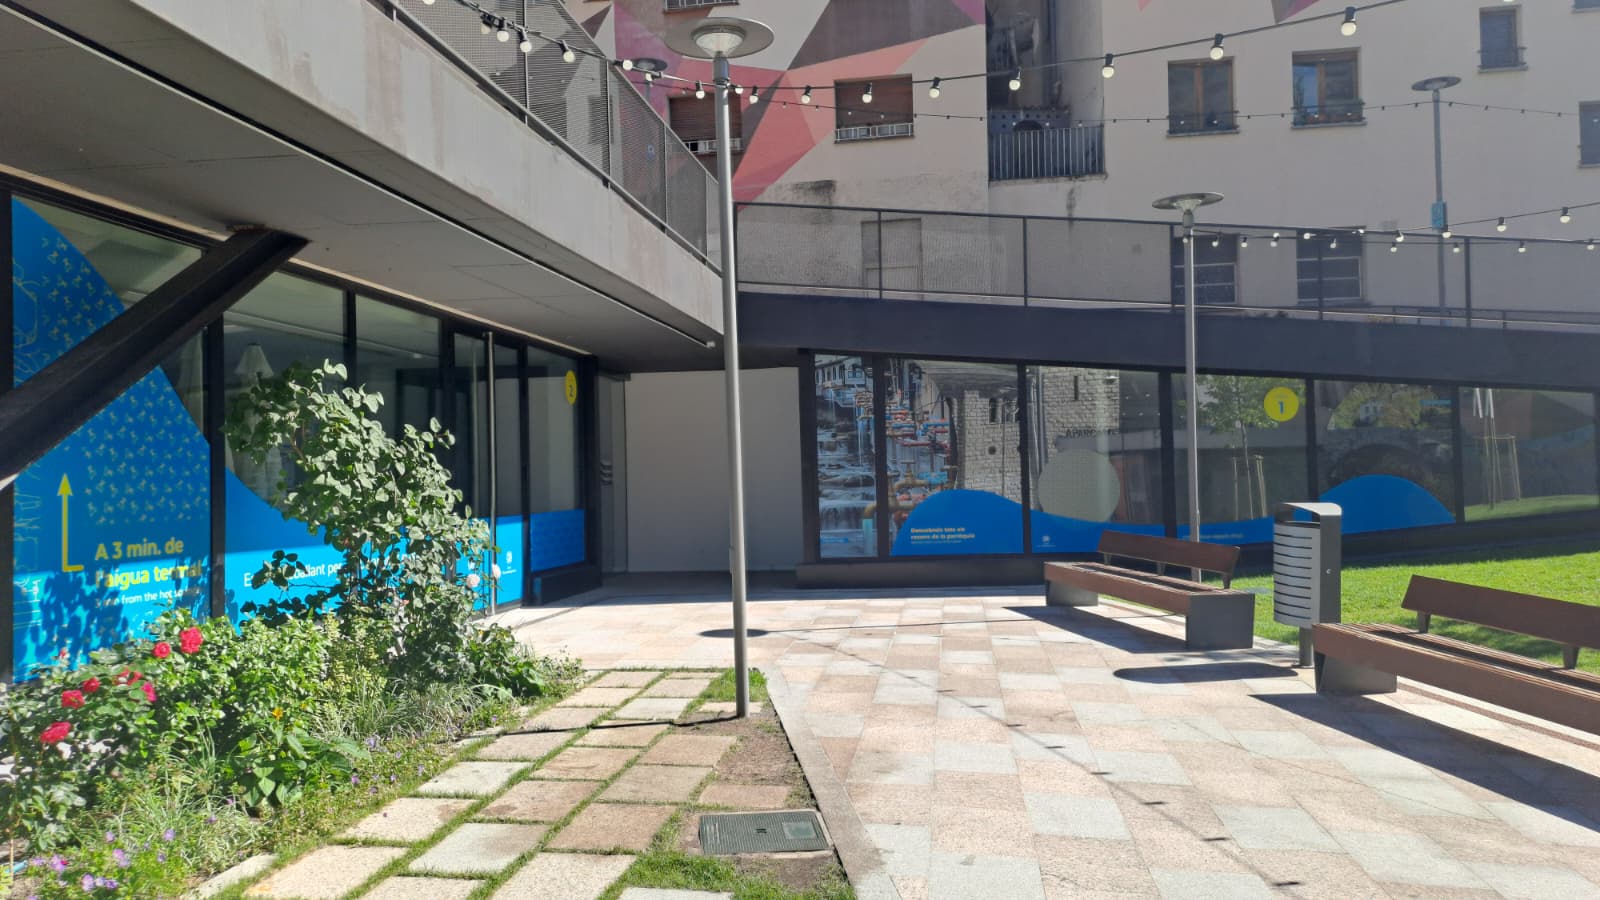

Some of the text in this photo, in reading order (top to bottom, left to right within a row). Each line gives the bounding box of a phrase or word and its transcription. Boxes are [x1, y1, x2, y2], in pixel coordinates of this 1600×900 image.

[1278, 401, 1285, 415] 1
[95, 537, 184, 561] A 3 min. de
[96, 560, 202, 591] l'aigua termal
[122, 594, 142, 605] from
[144, 592, 158, 602] the
[160, 589, 171, 600] hot
